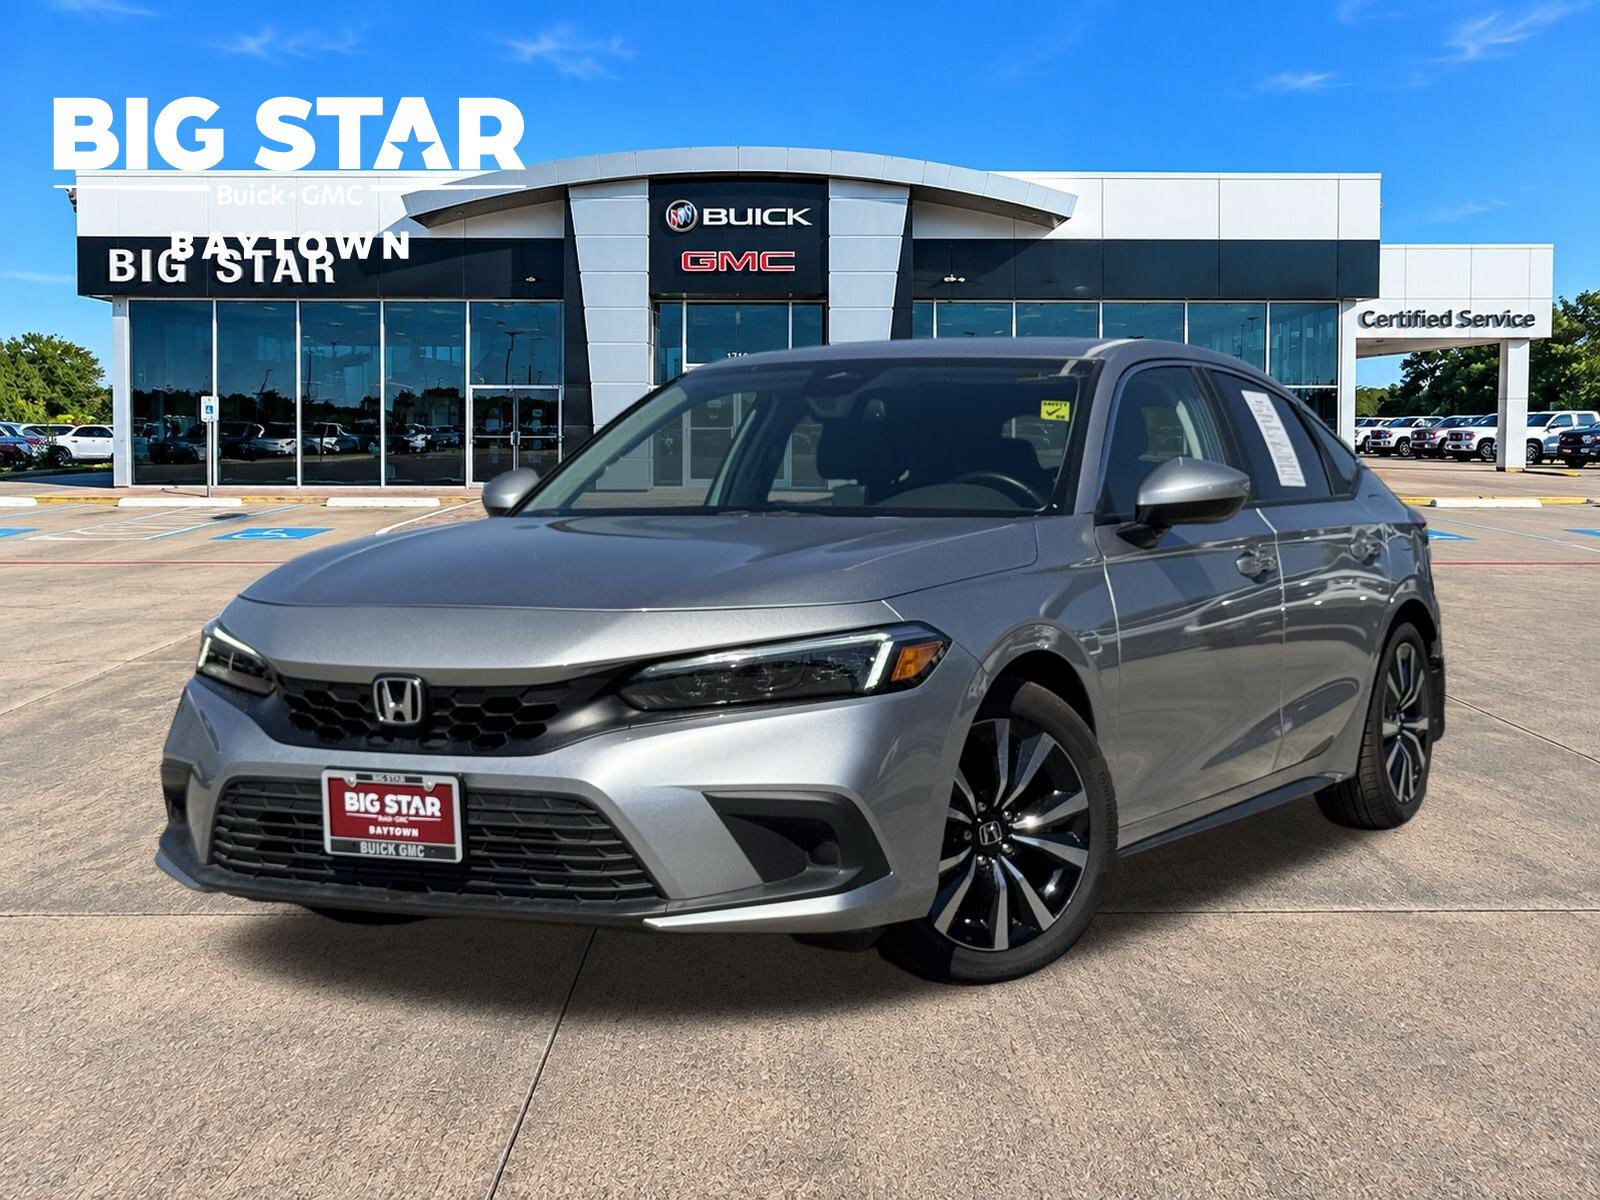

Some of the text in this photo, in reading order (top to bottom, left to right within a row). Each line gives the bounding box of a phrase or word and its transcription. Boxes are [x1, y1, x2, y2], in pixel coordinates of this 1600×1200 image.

[703, 208, 813, 226] BUICK
[108, 248, 335, 283] BIG STAR
[681, 251, 796, 272] GMC
[1360, 309, 1536, 328] Certified Service
[345, 792, 441, 816] BIG STAR
[368, 825, 419, 837] BAYTOWN
[360, 841, 425, 857] BUICK GMC
